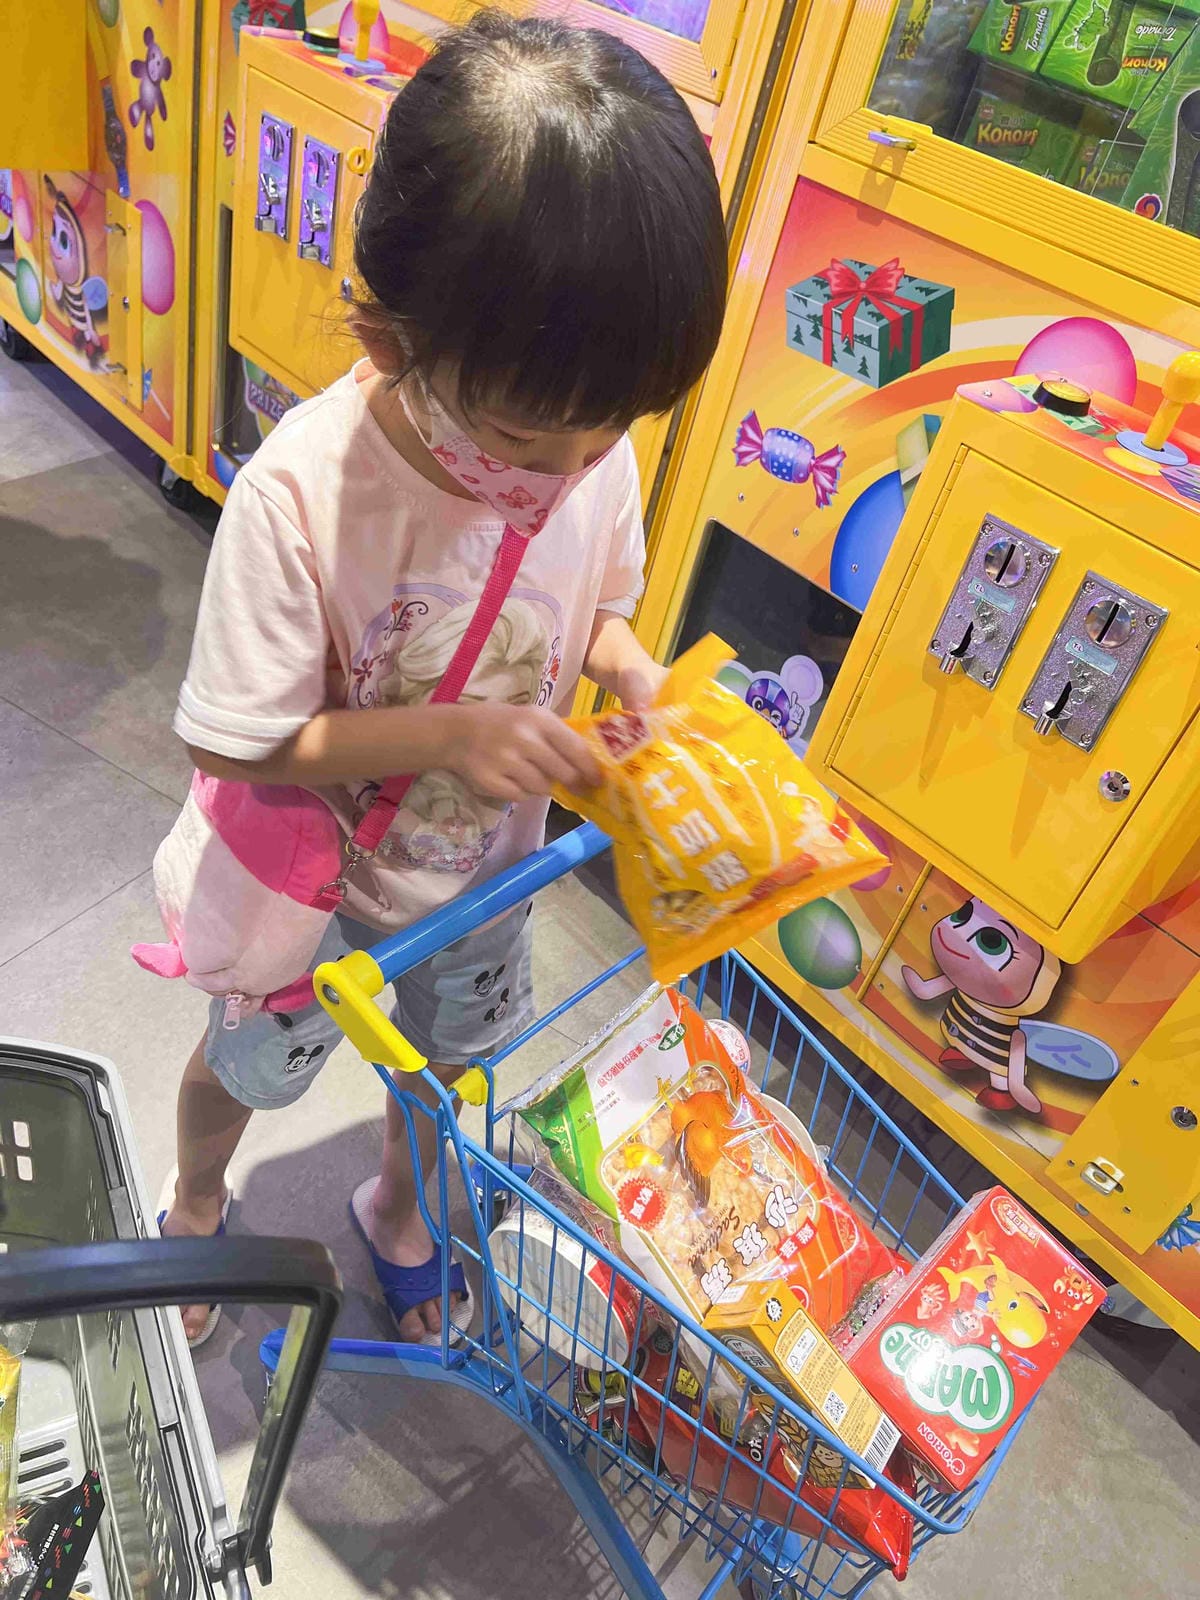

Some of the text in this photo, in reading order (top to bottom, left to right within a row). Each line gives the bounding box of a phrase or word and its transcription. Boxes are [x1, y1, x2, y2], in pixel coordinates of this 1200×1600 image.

[1025, 7, 1048, 52] Tornado
[1135, 24, 1177, 43] Tornado
[688, 1206, 740, 1269] Sachima
[701, 1185, 798, 1305] 沙琪瑪
[780, 1222, 815, 1259] 雞蛋
[917, 1422, 953, 1464] ORION
